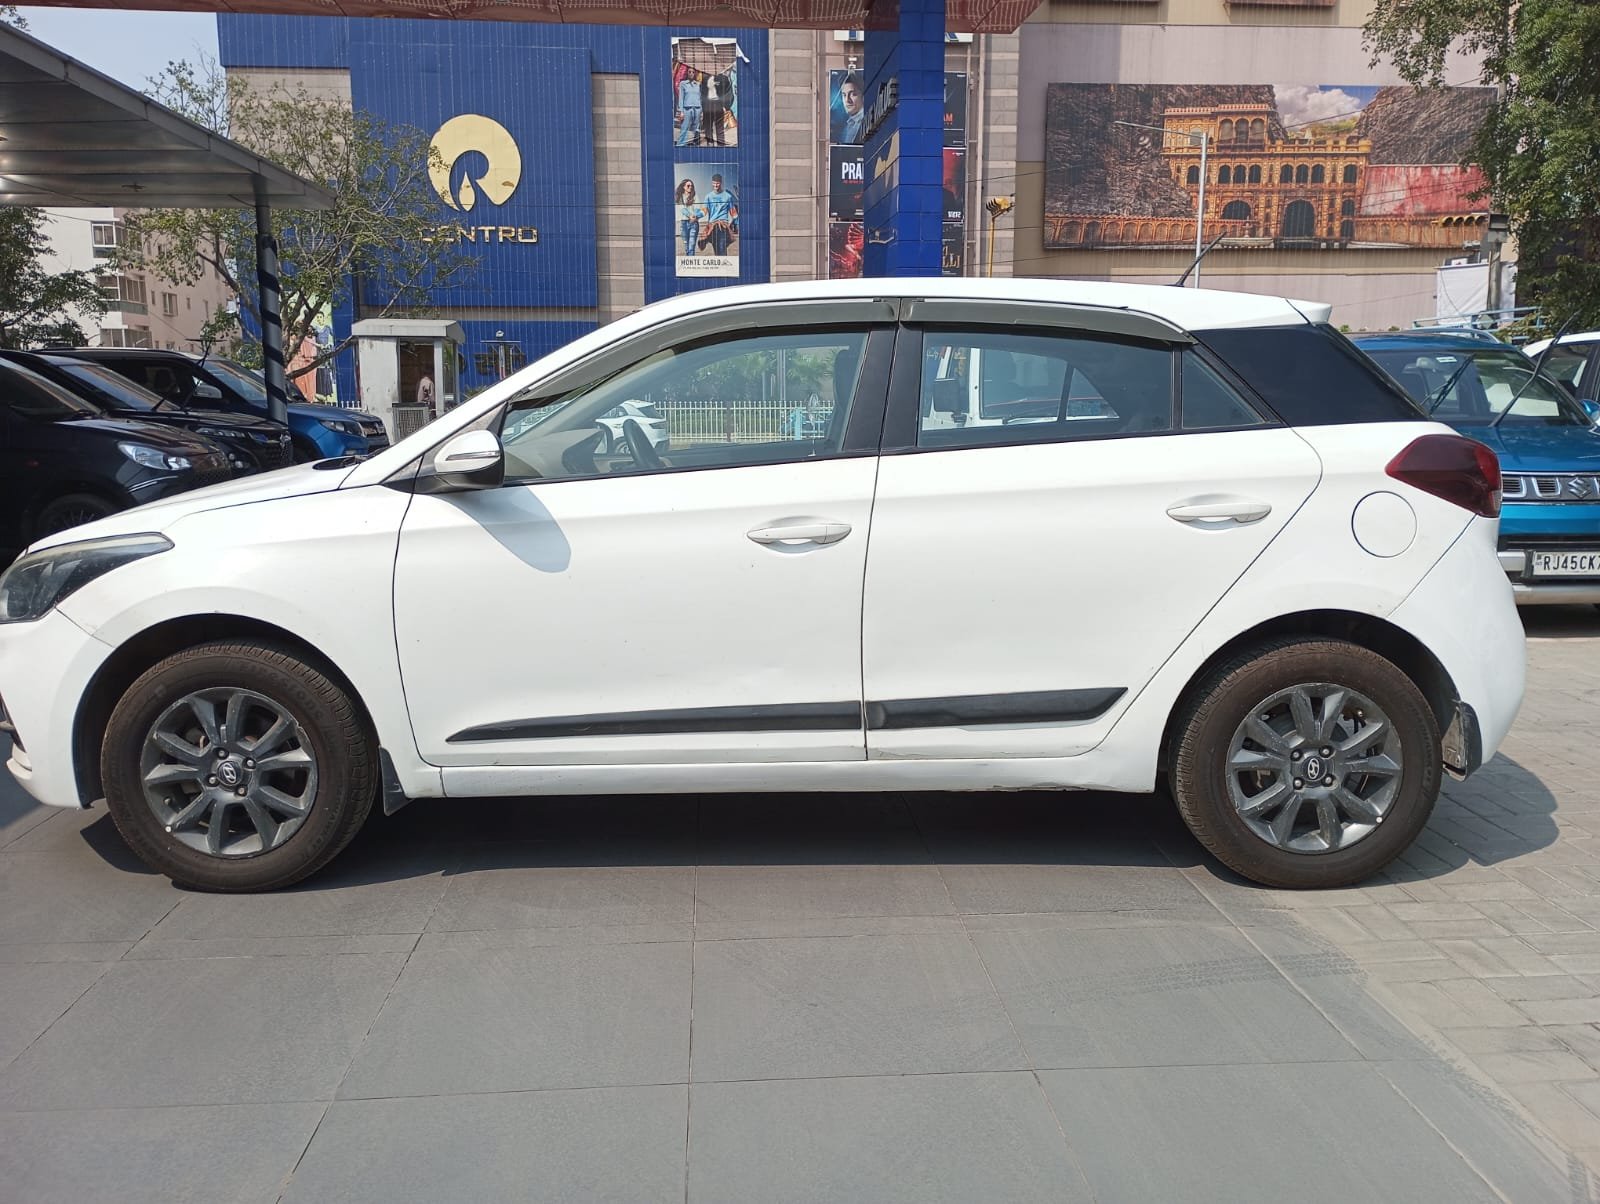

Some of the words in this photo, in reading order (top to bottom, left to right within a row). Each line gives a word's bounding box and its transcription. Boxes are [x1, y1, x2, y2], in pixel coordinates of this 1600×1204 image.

[842, 162, 865, 180] PRA
[681, 259, 701, 267] MONTE
[703, 259, 721, 267] CARLO
